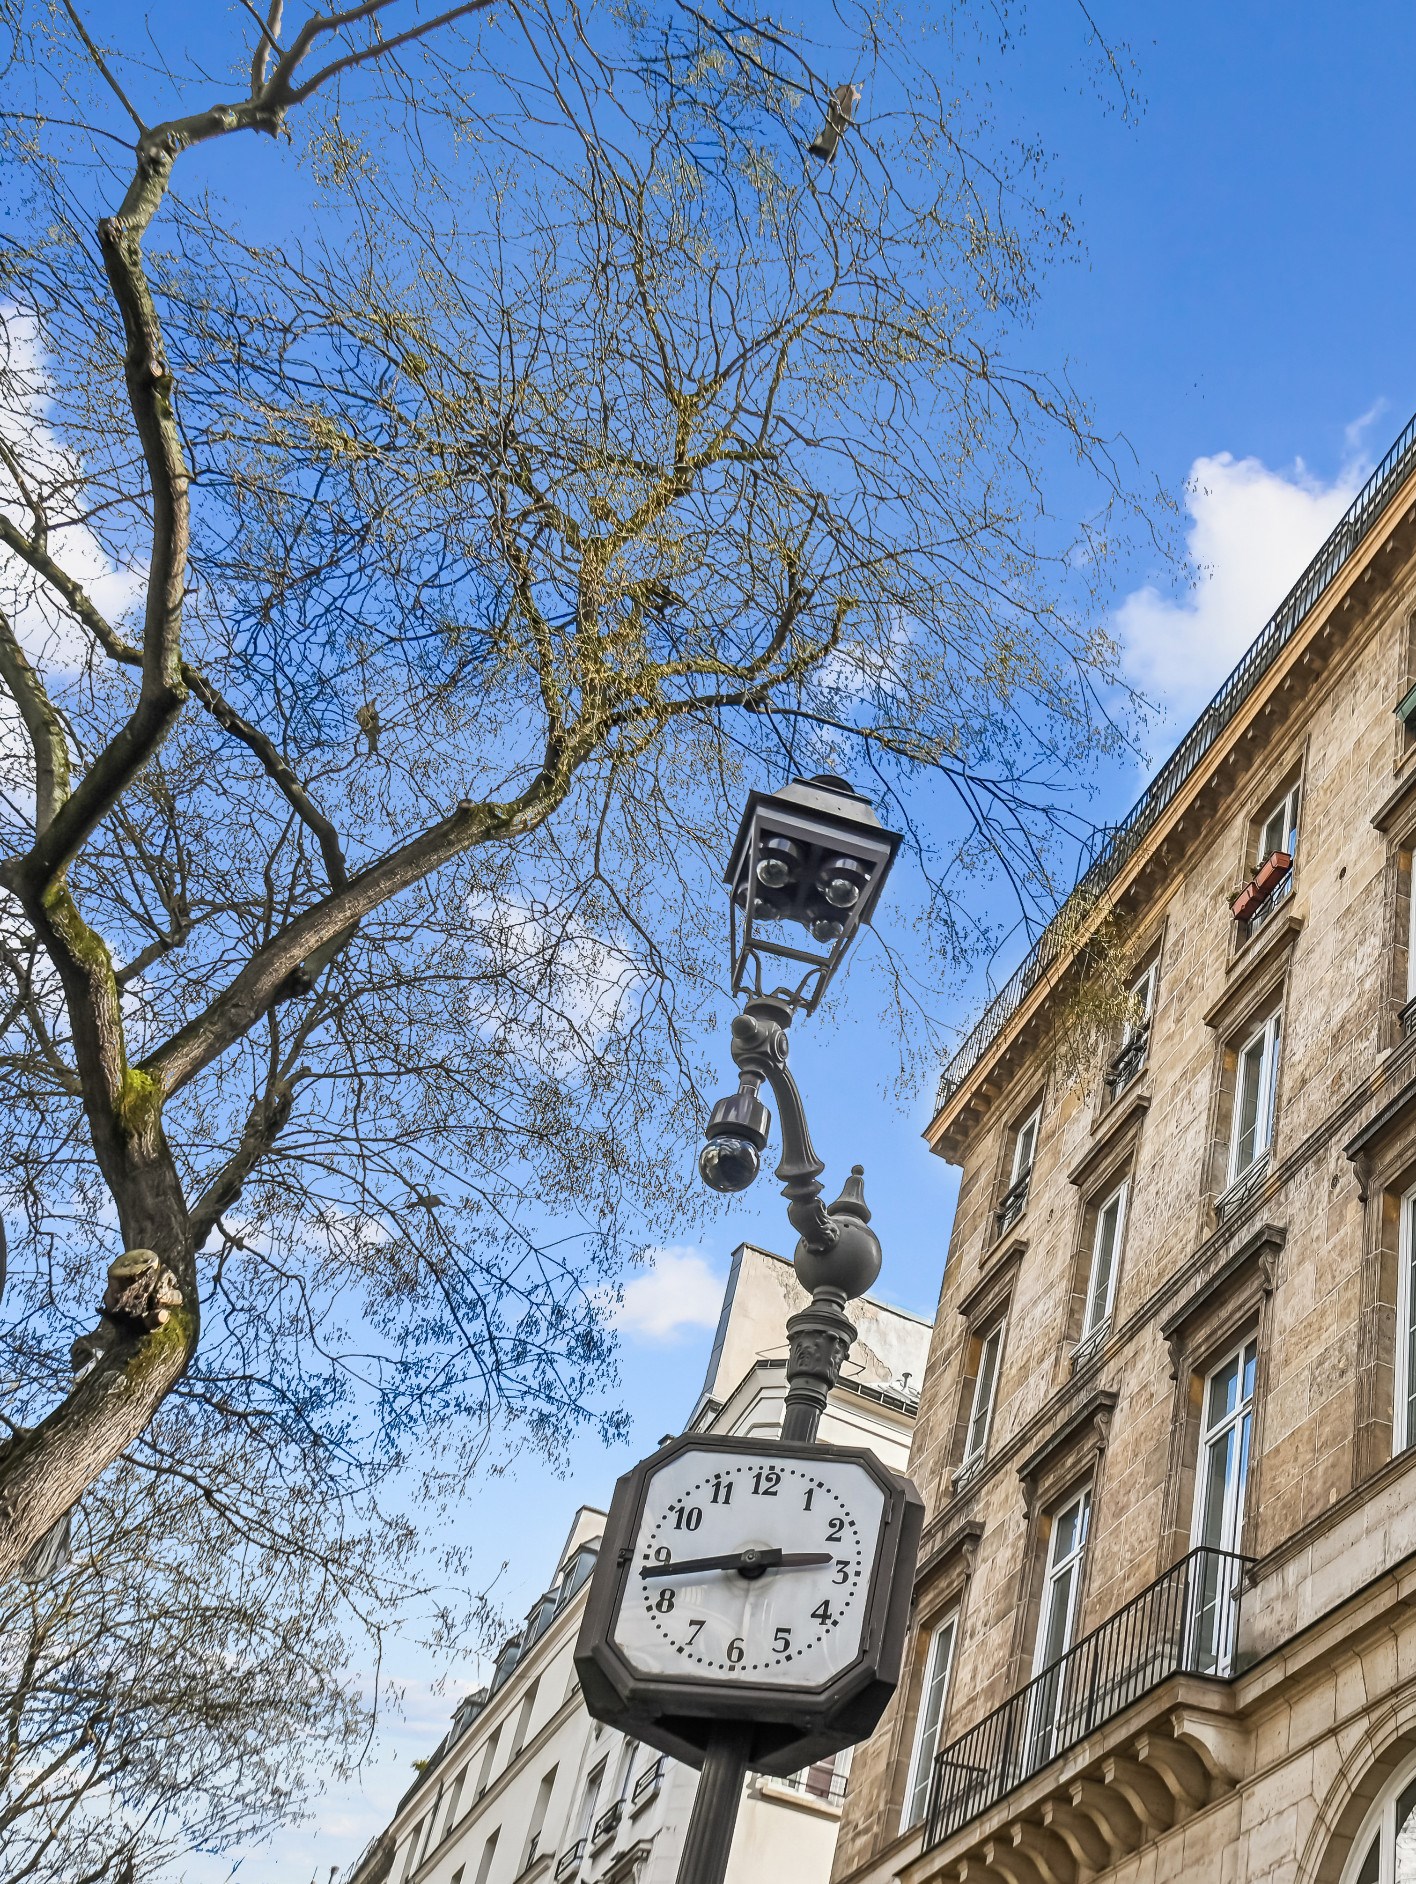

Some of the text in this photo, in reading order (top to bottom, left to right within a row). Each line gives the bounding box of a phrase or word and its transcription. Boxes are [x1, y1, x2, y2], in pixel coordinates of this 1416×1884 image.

[710, 1481, 733, 1504] 11
[752, 1472, 781, 1496] 12
[803, 1488, 813, 1511] 1
[674, 1506, 702, 1531] 10
[825, 1518, 844, 1542] 2
[655, 1546, 671, 1572] 9
[832, 1560, 850, 1584] 3
[656, 1588, 675, 1613] 8
[811, 1600, 832, 1625] 4
[685, 1620, 706, 1645] 7
[772, 1628, 791, 1653] 5
[727, 1638, 744, 1663] 6
